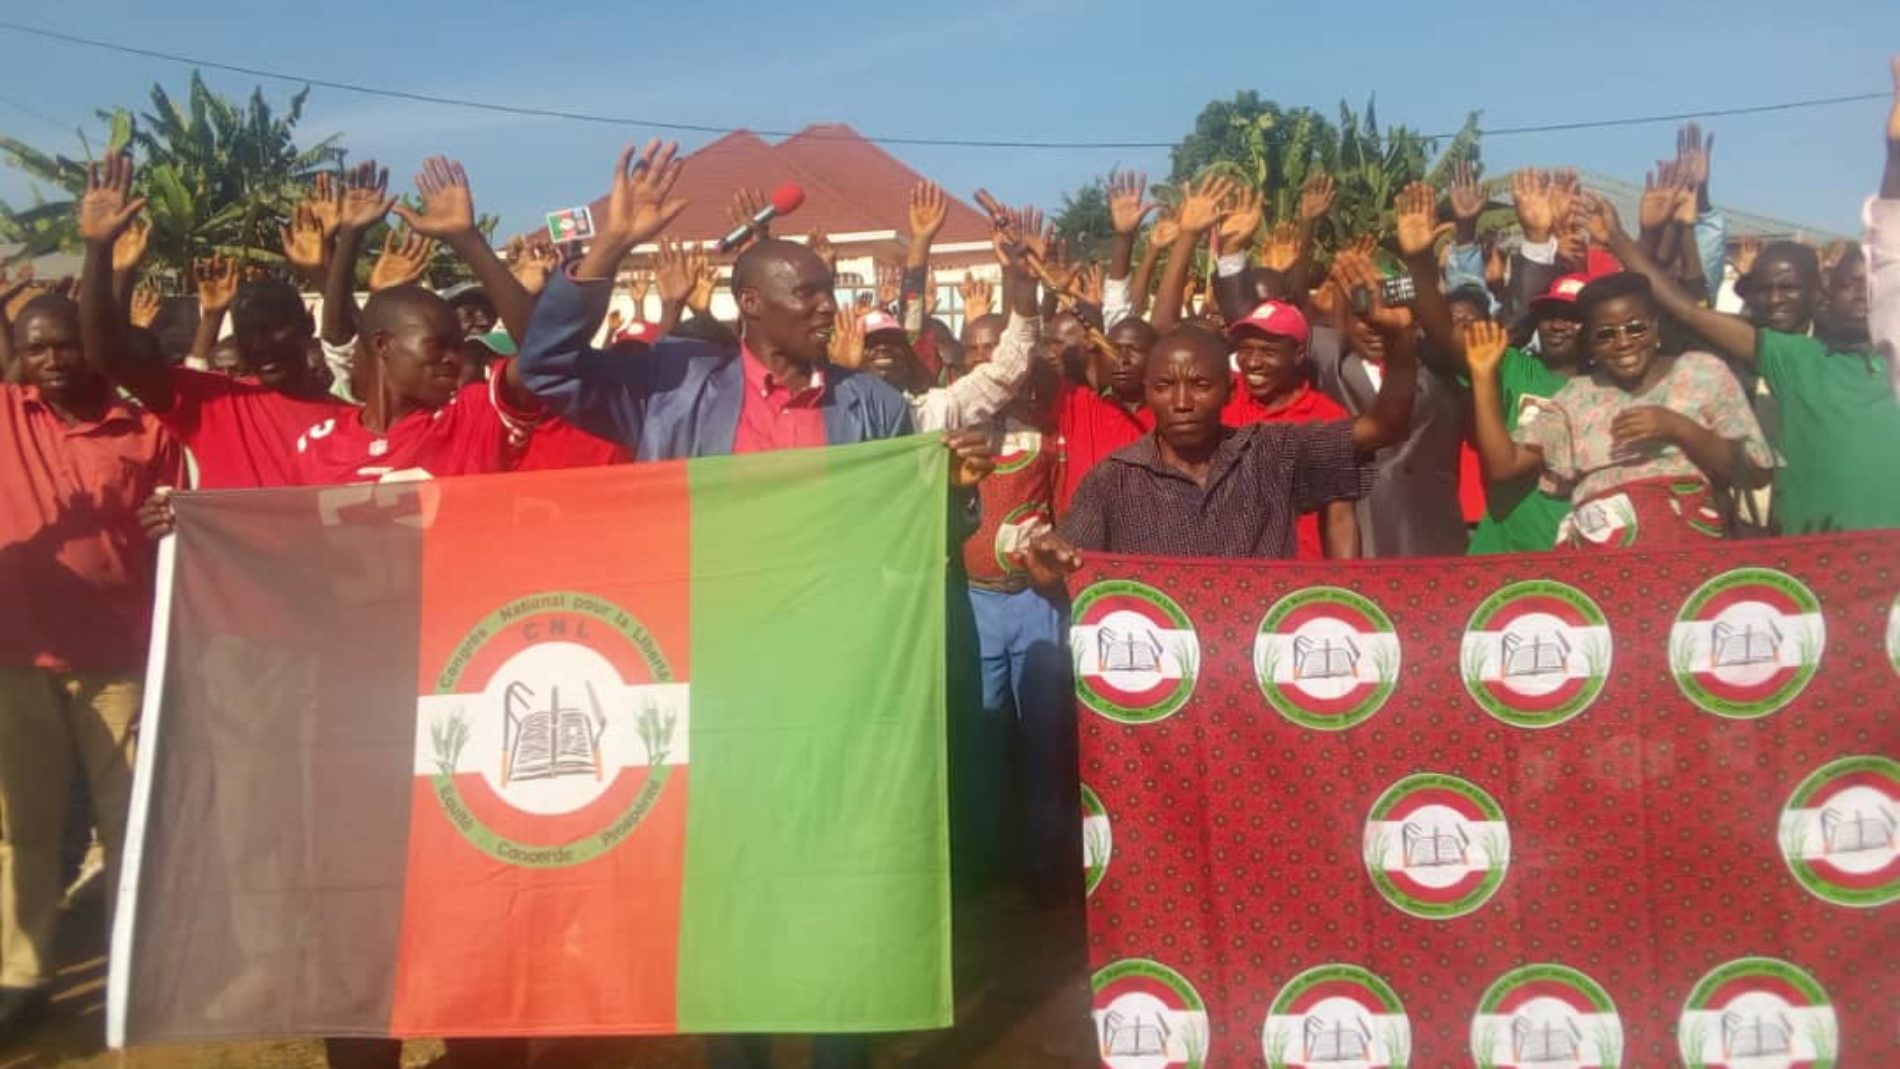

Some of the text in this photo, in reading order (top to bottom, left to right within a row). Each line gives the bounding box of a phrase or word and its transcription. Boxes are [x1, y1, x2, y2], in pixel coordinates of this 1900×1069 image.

[499, 595, 564, 622] National
[572, 597, 612, 616] pour
[615, 611, 629, 629] la
